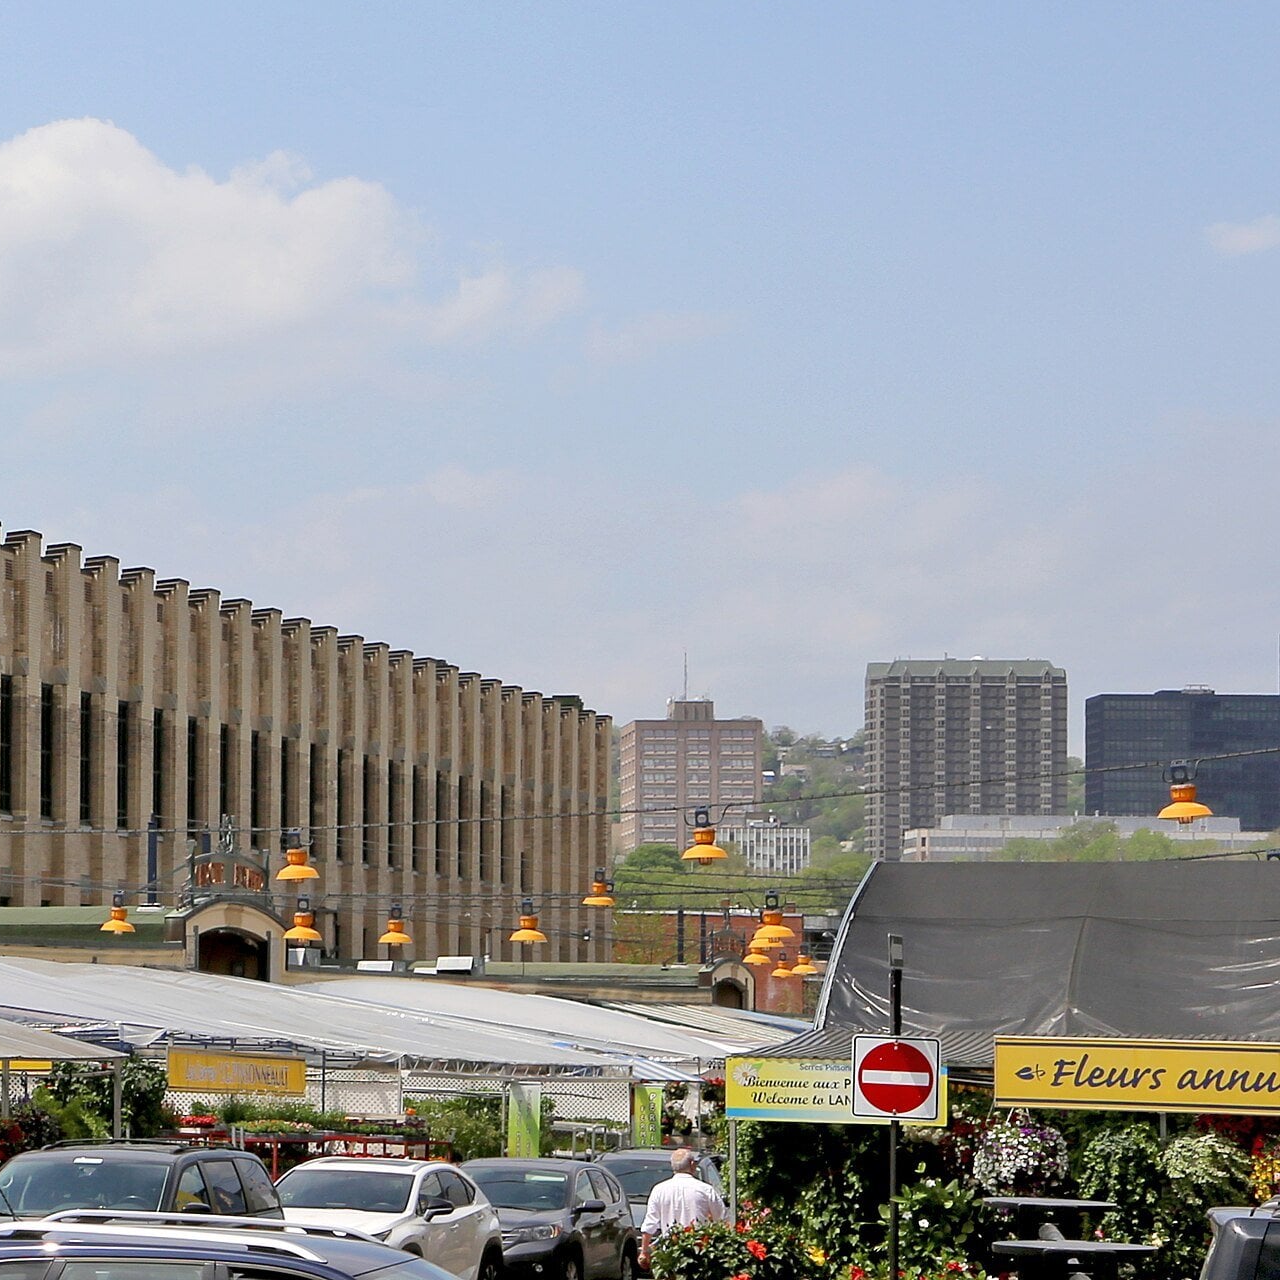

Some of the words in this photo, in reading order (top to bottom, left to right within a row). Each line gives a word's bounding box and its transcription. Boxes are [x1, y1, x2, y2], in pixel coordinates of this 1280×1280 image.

[1050, 1053, 1167, 1090] Fleurs
[1177, 1067, 1280, 1093] annu
[744, 1076, 809, 1089] Bienvenue
[813, 1081, 840, 1089] aux
[751, 1092, 809, 1105] Welcome
[812, 1095, 824, 1105] to
